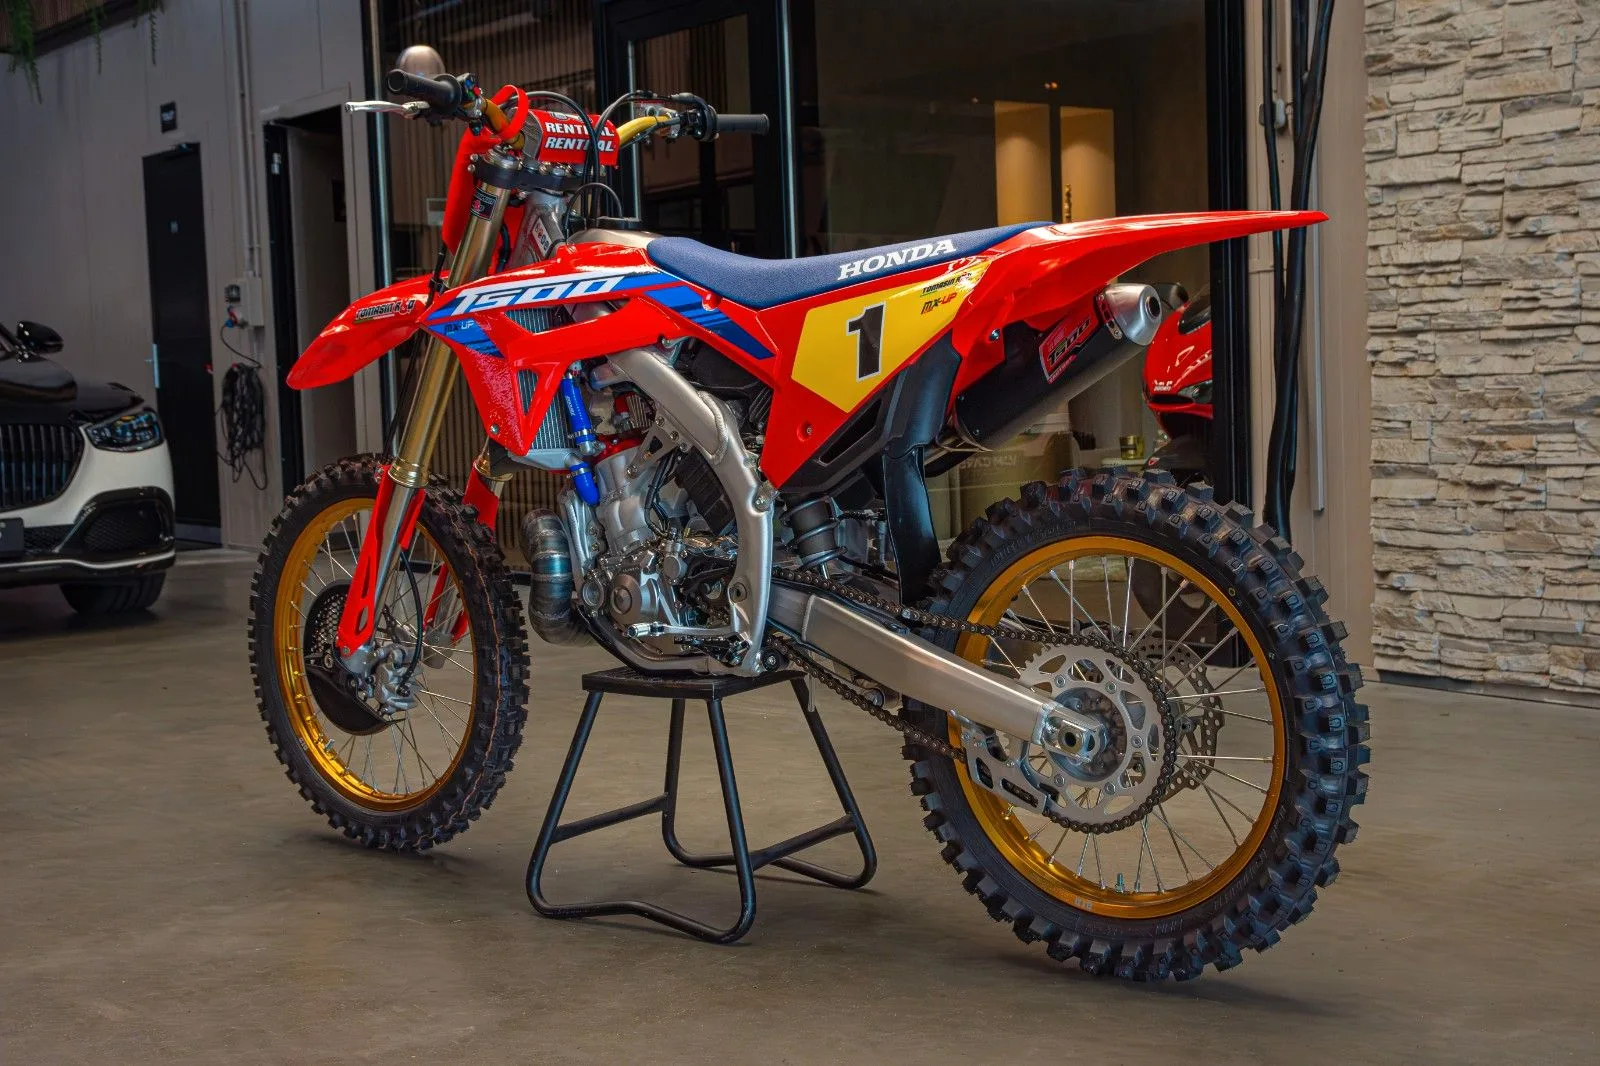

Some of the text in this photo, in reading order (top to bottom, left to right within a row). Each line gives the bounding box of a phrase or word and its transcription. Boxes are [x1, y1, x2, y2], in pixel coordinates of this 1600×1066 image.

[545, 122, 615, 137] RENTL
[837, 240, 957, 281] HONDA
[920, 292, 958, 315] MX-UP
[444, 319, 475, 336] MX-UP
[846, 301, 886, 383] 1
